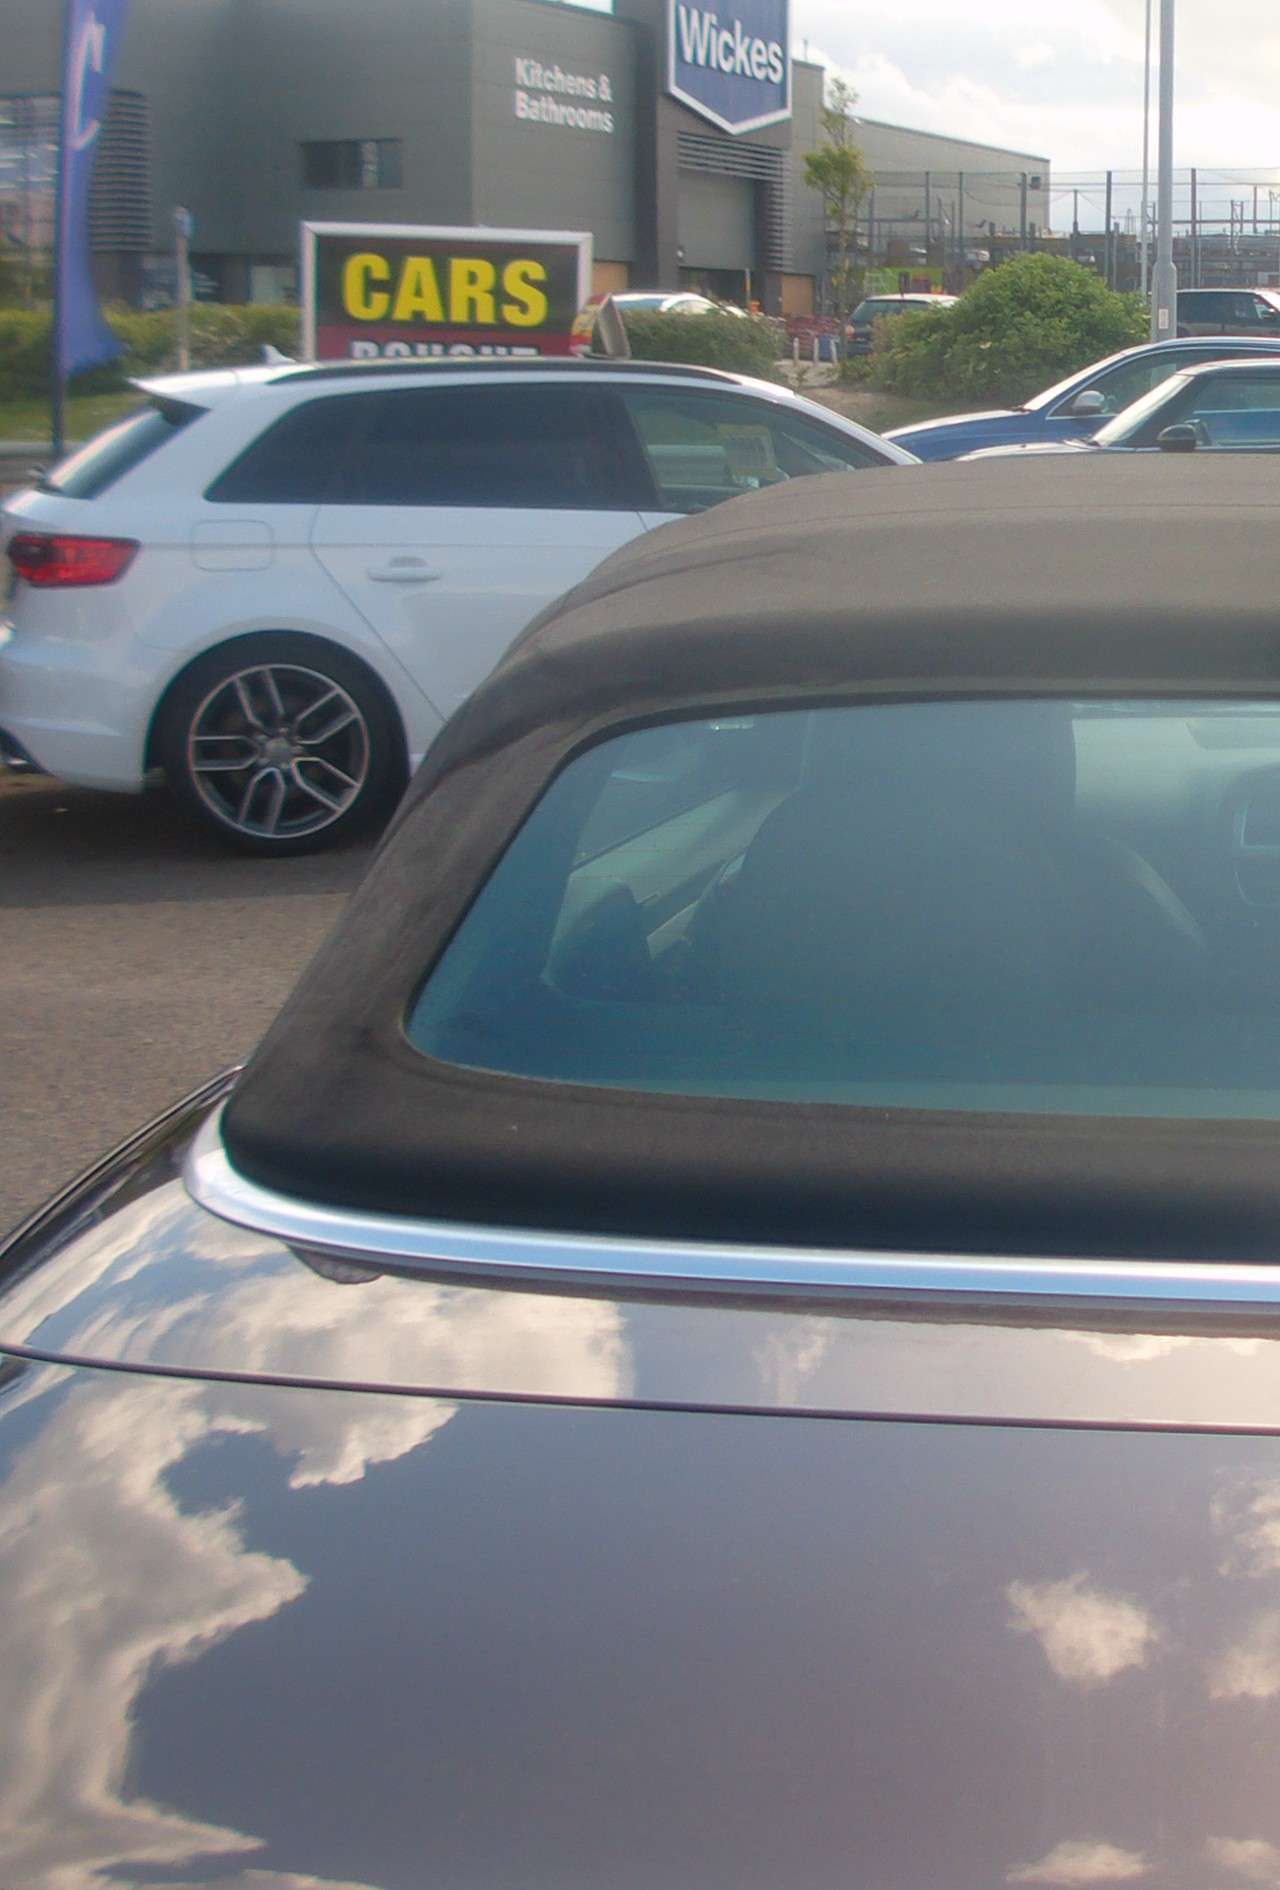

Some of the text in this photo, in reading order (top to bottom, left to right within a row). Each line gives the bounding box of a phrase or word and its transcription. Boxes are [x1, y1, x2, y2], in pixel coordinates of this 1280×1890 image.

[679, 4, 783, 84] Wickes
[514, 57, 613, 101] Kitchens &
[514, 89, 614, 134] Bathrooms
[342, 252, 549, 327] CARS
